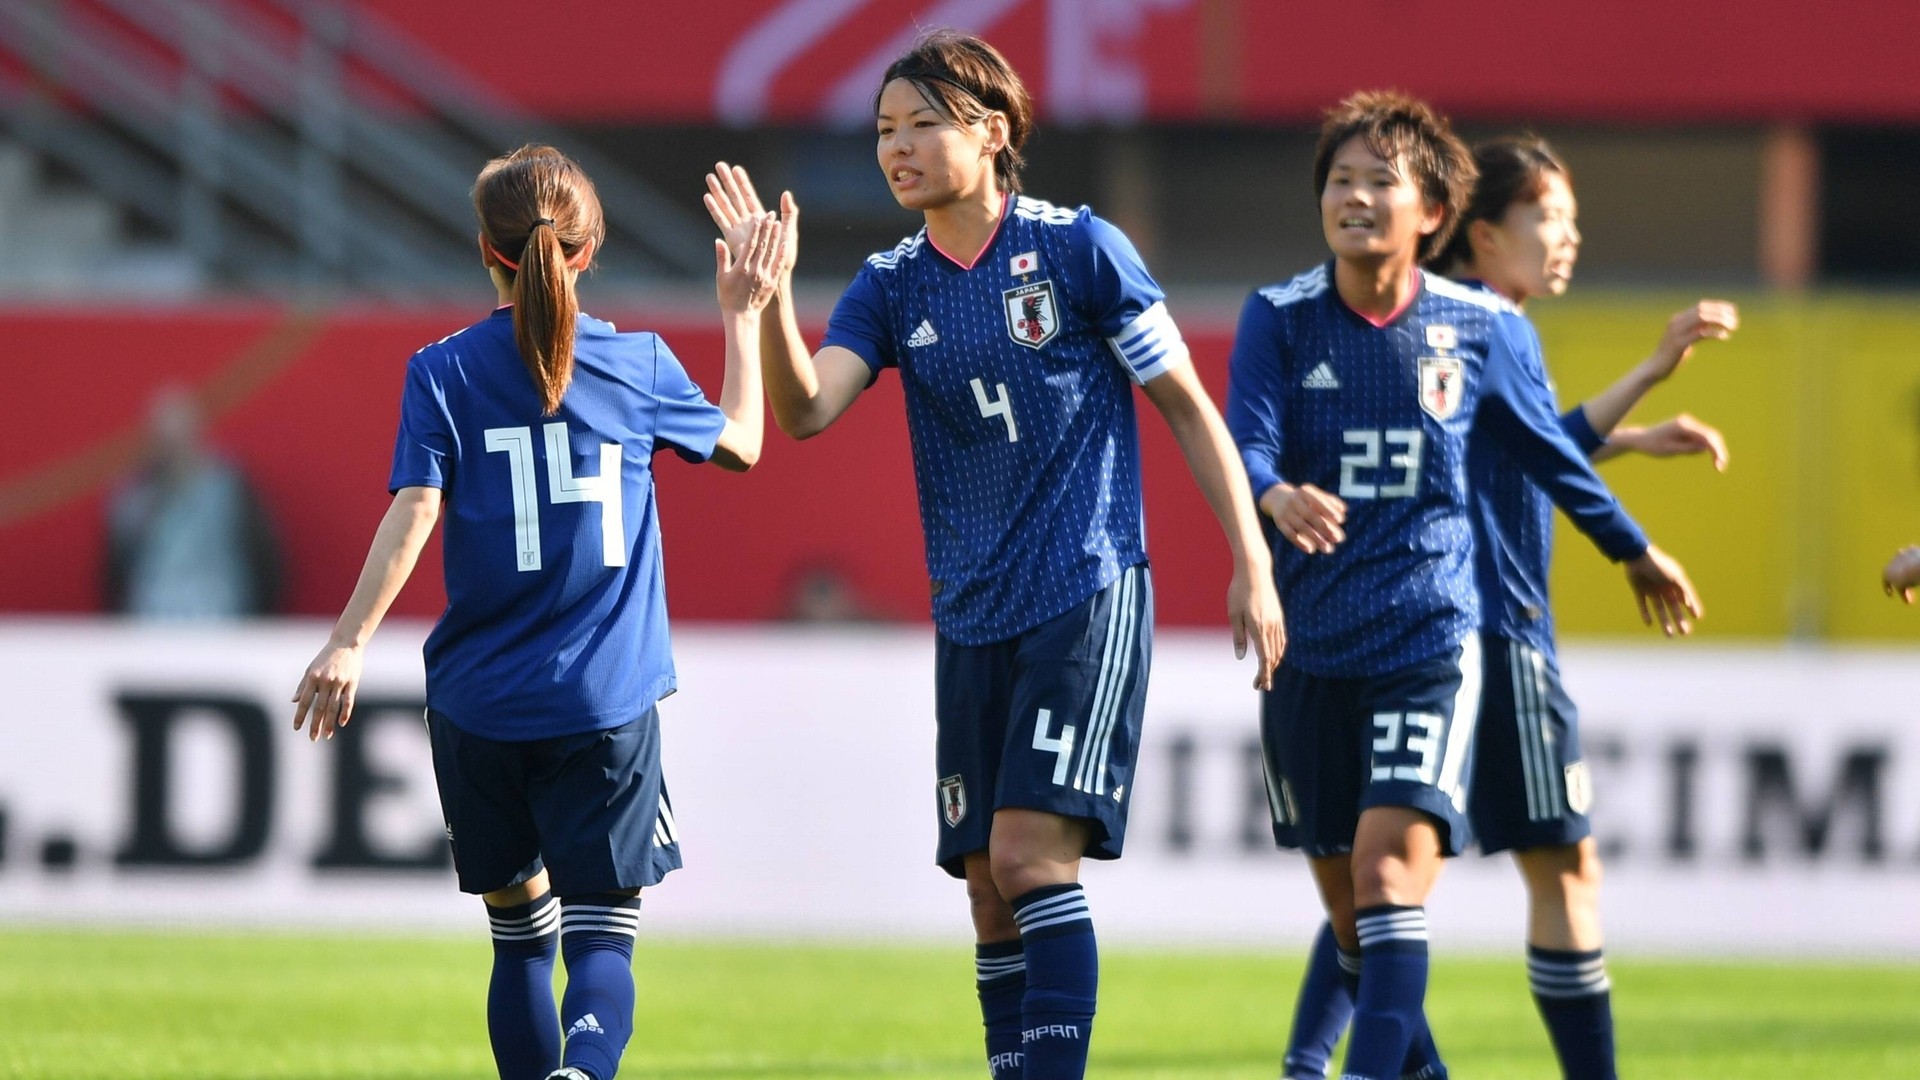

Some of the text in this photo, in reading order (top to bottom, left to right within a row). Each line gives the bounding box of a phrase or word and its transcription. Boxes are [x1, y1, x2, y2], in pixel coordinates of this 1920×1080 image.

[1015, 285, 1040, 296] JAPAN
[907, 334, 938, 348] adidas
[970, 378, 1018, 443] 4
[1301, 378, 1339, 389] adidas
[484, 421, 626, 572] 14
[1339, 430, 1423, 499] 23
[1031, 708, 1075, 786] 4
[1370, 712, 1442, 785] 23
[1021, 1024, 1079, 1043] JAPAN
